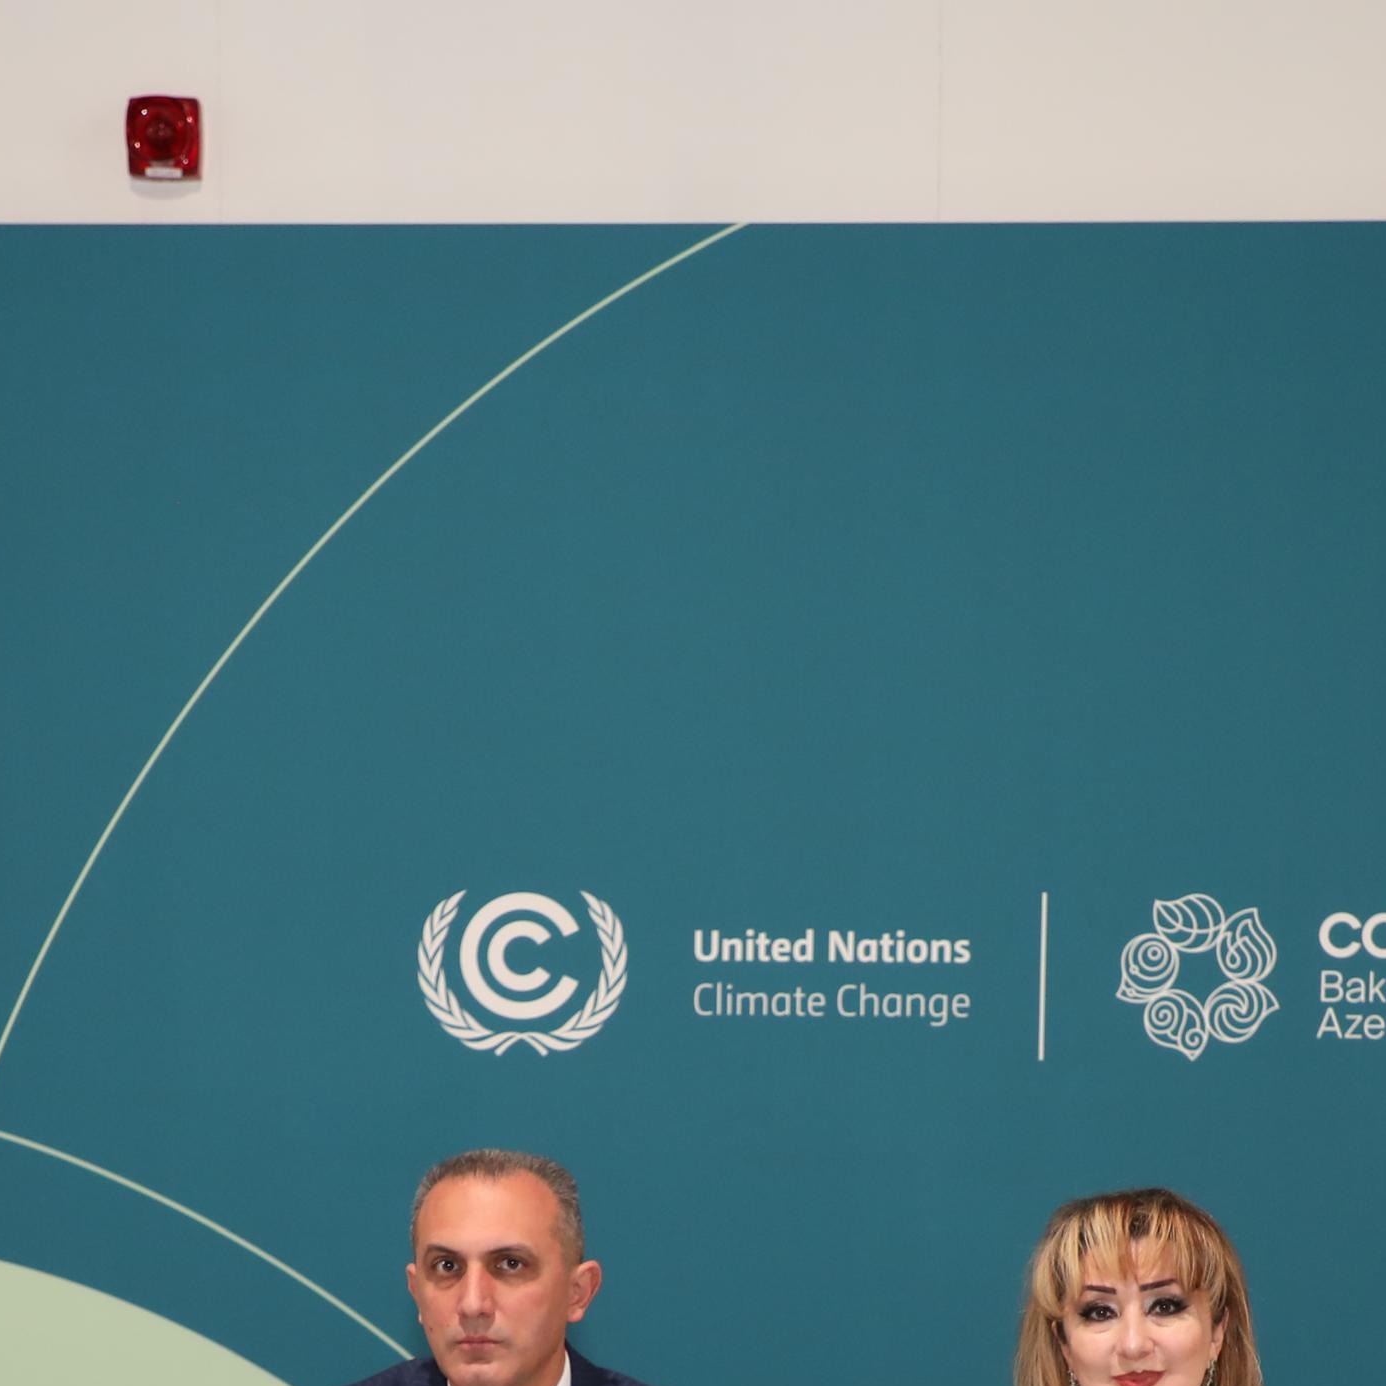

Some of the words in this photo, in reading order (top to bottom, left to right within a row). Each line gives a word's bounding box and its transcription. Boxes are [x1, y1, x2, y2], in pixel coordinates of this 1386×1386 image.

[694, 928, 814, 963] United
[828, 929, 972, 964] Nations
[693, 981, 827, 1017] Climate
[836, 982, 972, 1028] Change
